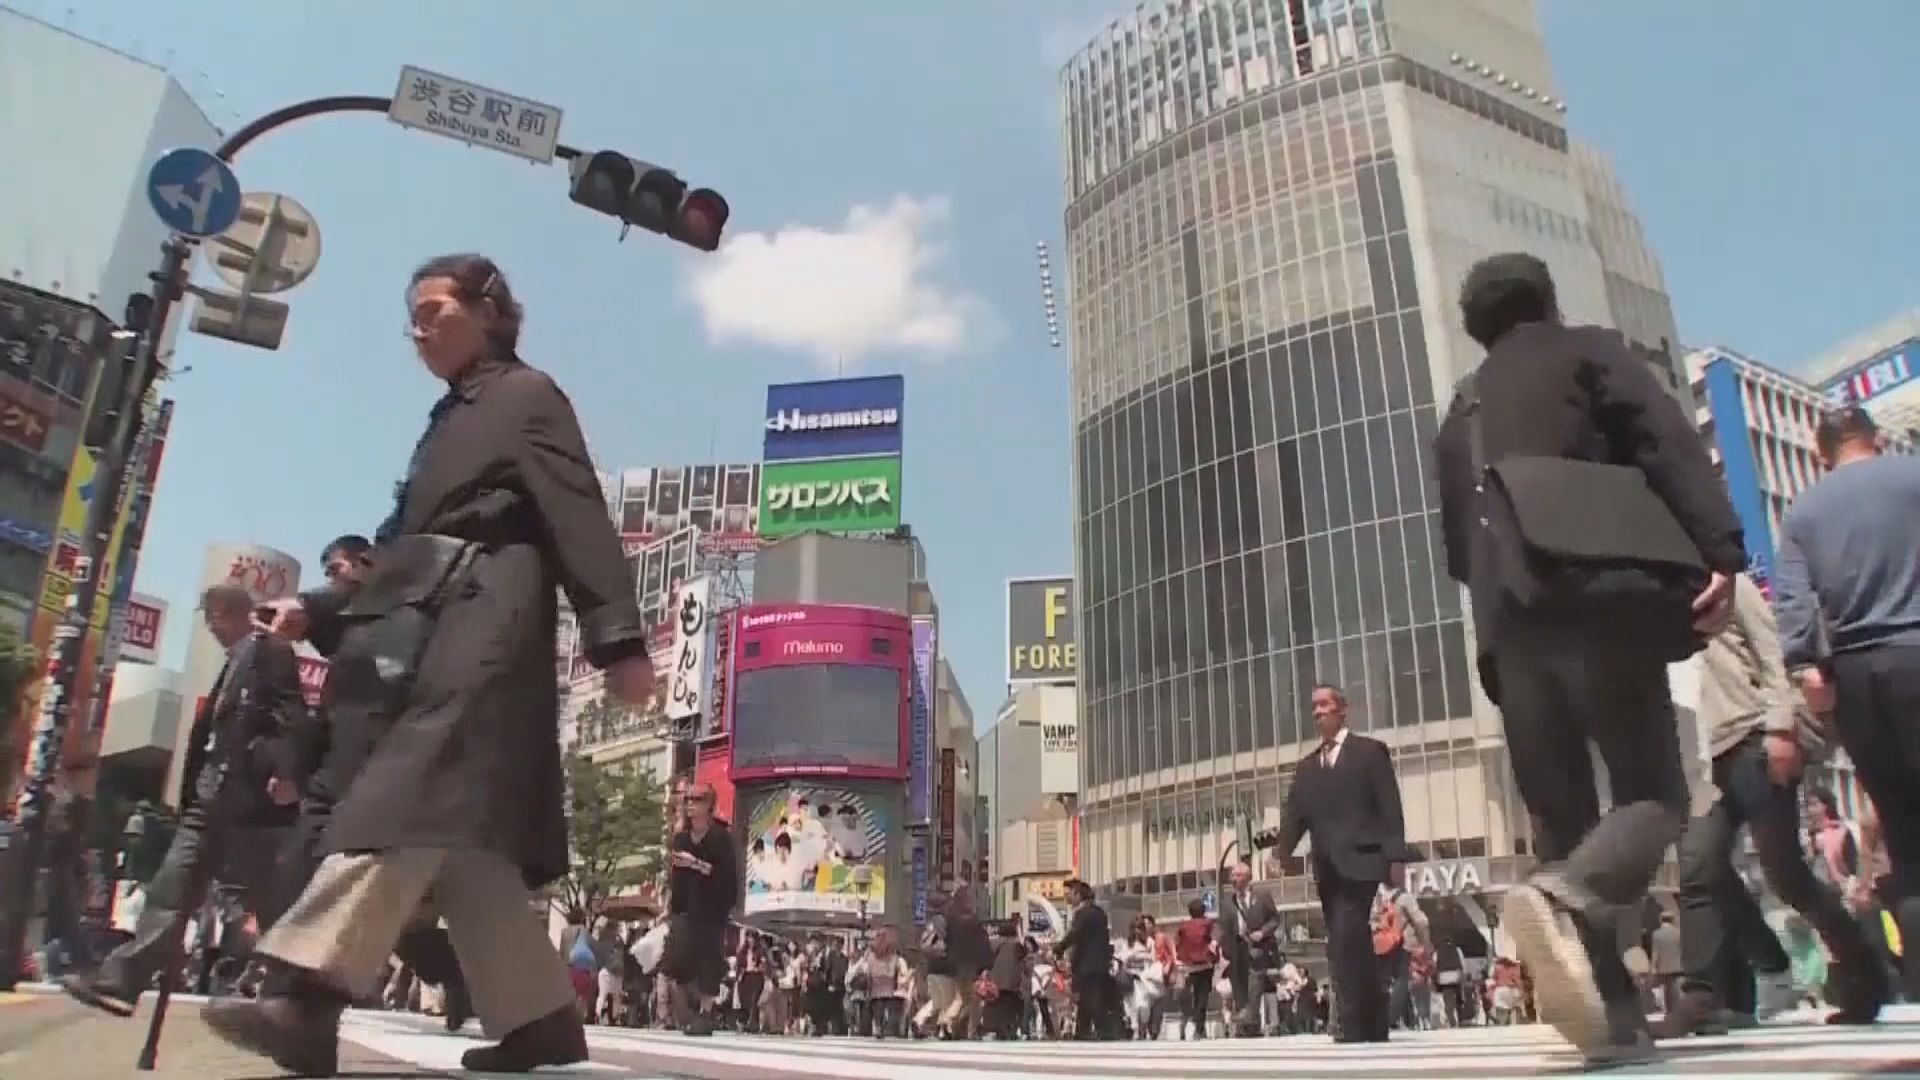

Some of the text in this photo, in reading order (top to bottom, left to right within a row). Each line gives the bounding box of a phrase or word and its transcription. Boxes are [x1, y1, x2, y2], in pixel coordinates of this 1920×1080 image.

[409, 78, 545, 136] 渋谷駅前
[425, 110, 489, 138] Shibuya
[766, 407, 898, 431] Hisamitsu
[767, 475, 891, 510] サロンパス
[673, 591, 704, 711] もんじゃ
[1014, 643, 1076, 671] FORE
[1043, 723, 1076, 739] VAMP
[1405, 862, 1481, 893] TAYA
